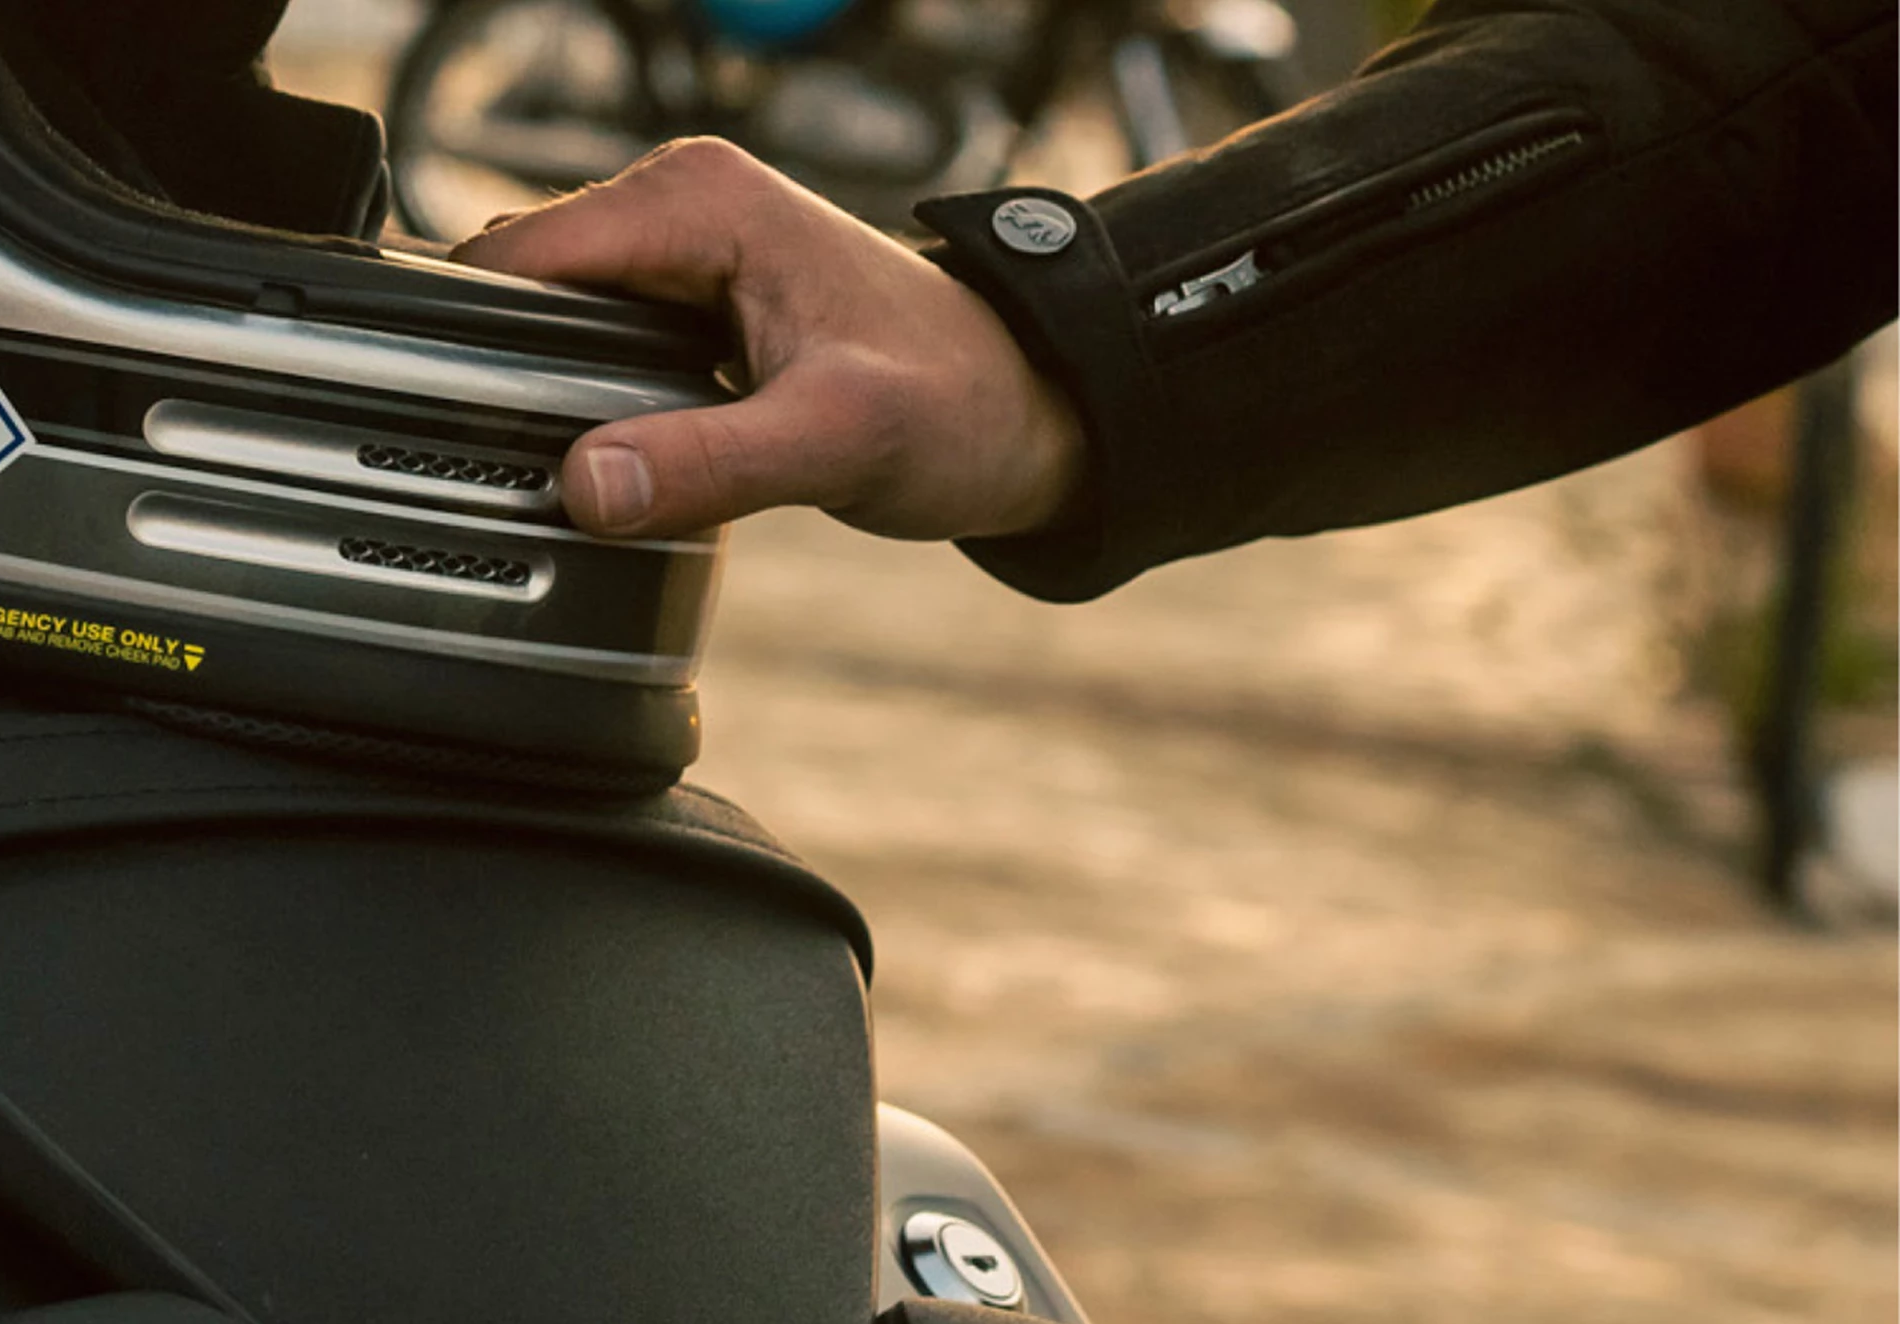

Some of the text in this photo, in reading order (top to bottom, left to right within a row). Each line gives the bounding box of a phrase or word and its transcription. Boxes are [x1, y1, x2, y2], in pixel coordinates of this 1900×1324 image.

[16, 627, 45, 645] AND
[47, 632, 105, 655] REMOVE
[106, 643, 150, 665] CHEEK
[152, 651, 181, 671] PAD
[71, 620, 116, 644] USE
[120, 629, 181, 655] ONLY
